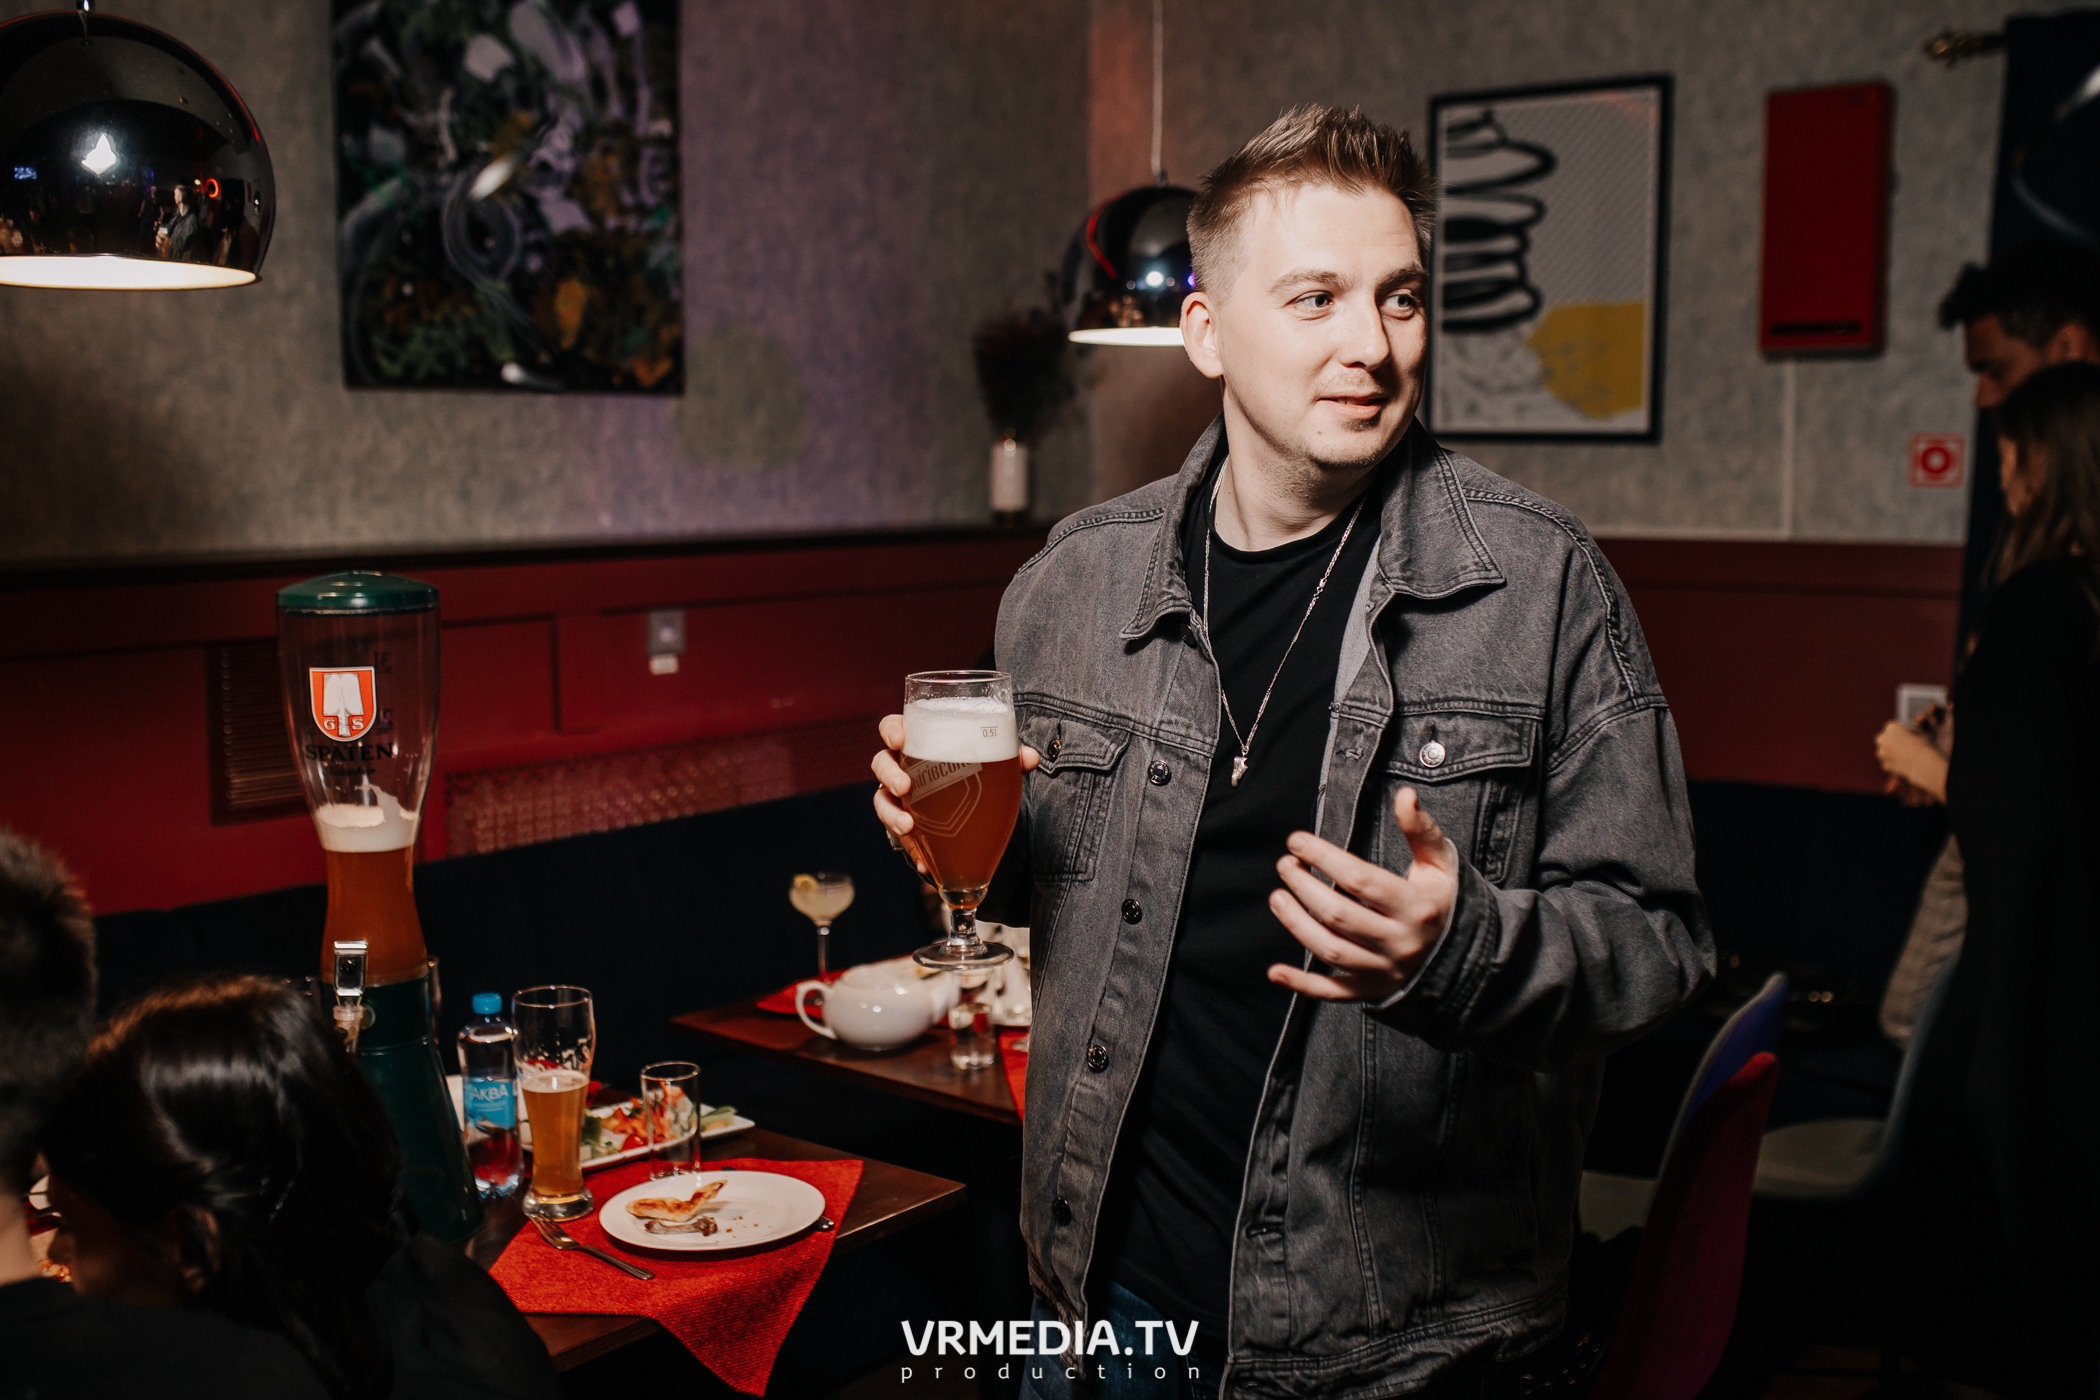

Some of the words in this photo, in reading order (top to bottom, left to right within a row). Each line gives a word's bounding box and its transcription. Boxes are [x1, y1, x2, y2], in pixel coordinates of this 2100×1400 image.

[323, 718, 336, 730] G
[351, 717, 364, 730] S
[305, 742, 393, 762] SPATEN
[470, 1083, 509, 1102] АКВА
